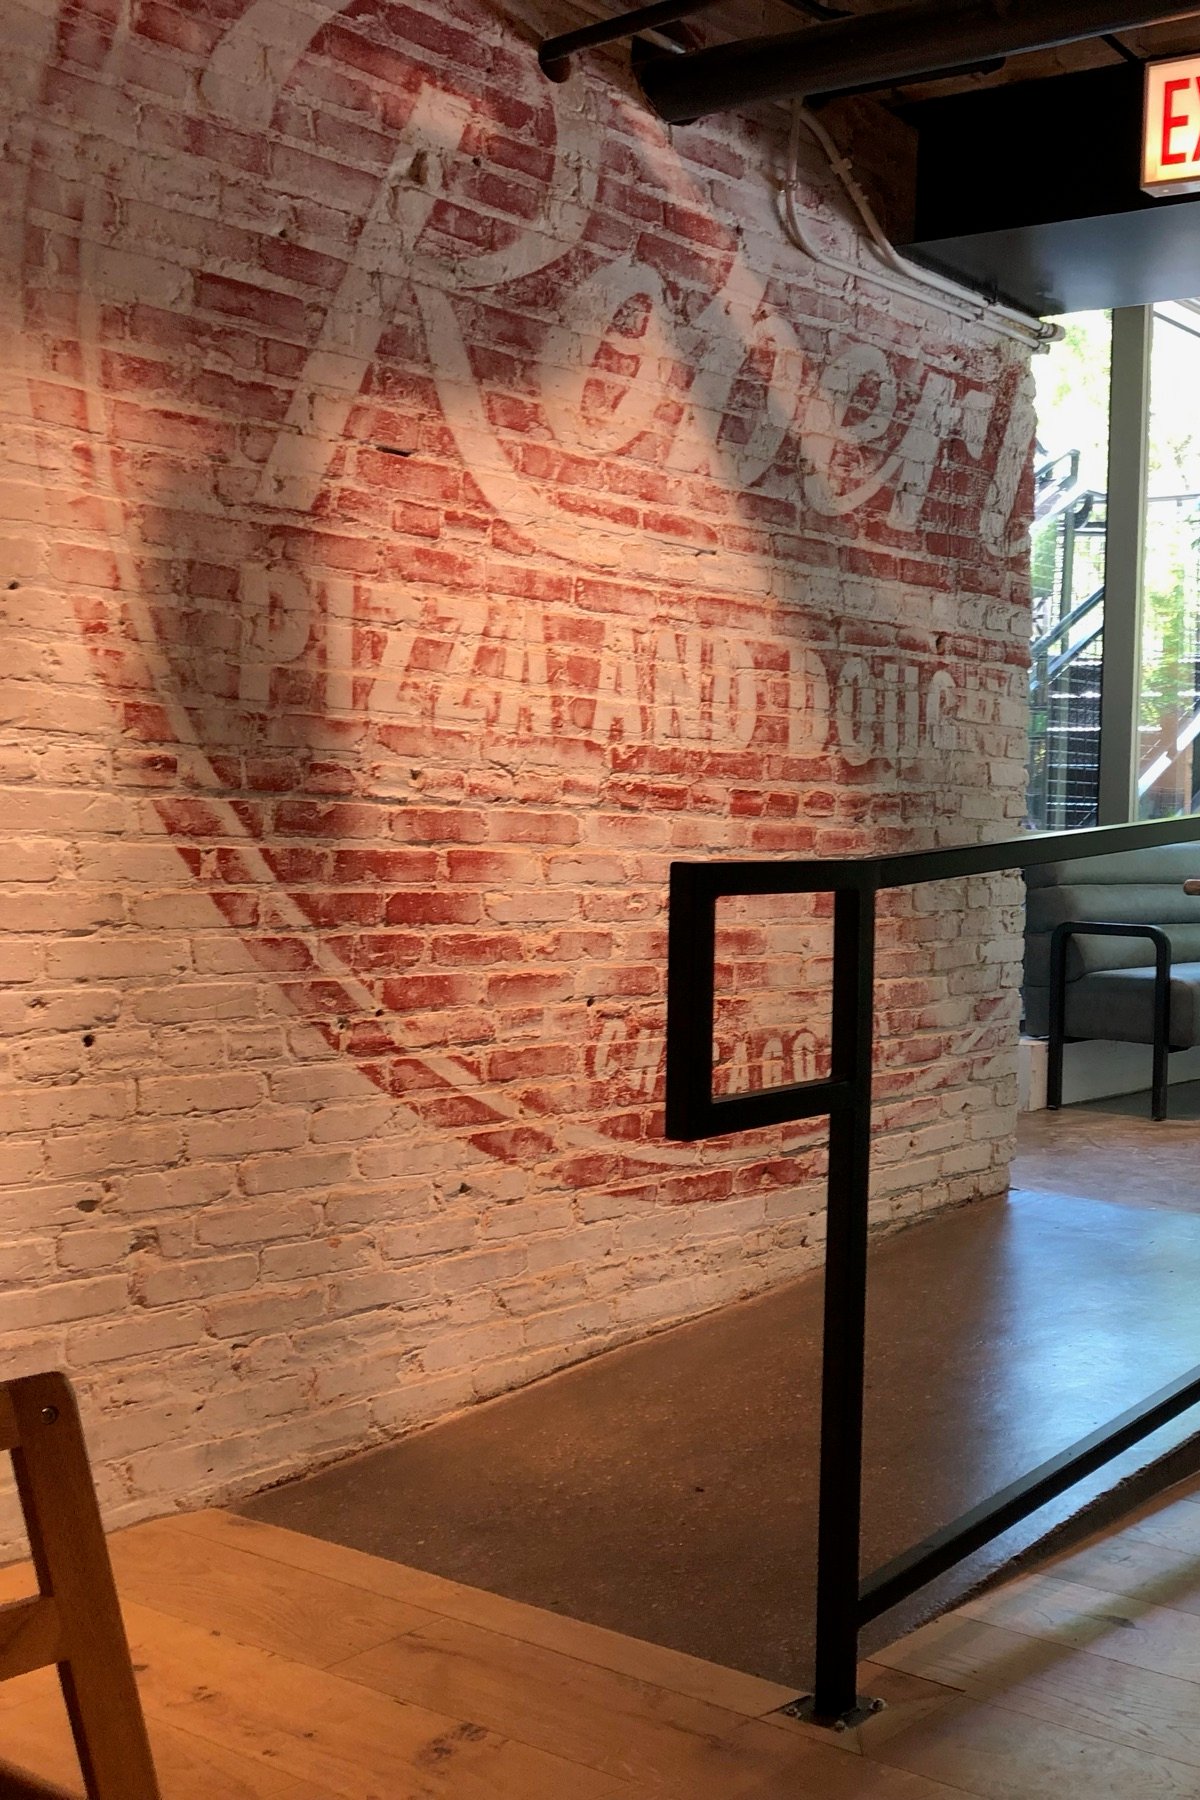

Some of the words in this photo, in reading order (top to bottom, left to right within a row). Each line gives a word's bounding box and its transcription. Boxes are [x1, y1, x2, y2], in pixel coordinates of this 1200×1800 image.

[238, 563, 554, 734] PIZZA
[590, 628, 759, 751] AND
[786, 647, 1004, 767] DOUGH
[592, 1017, 820, 1102] CHAGO
